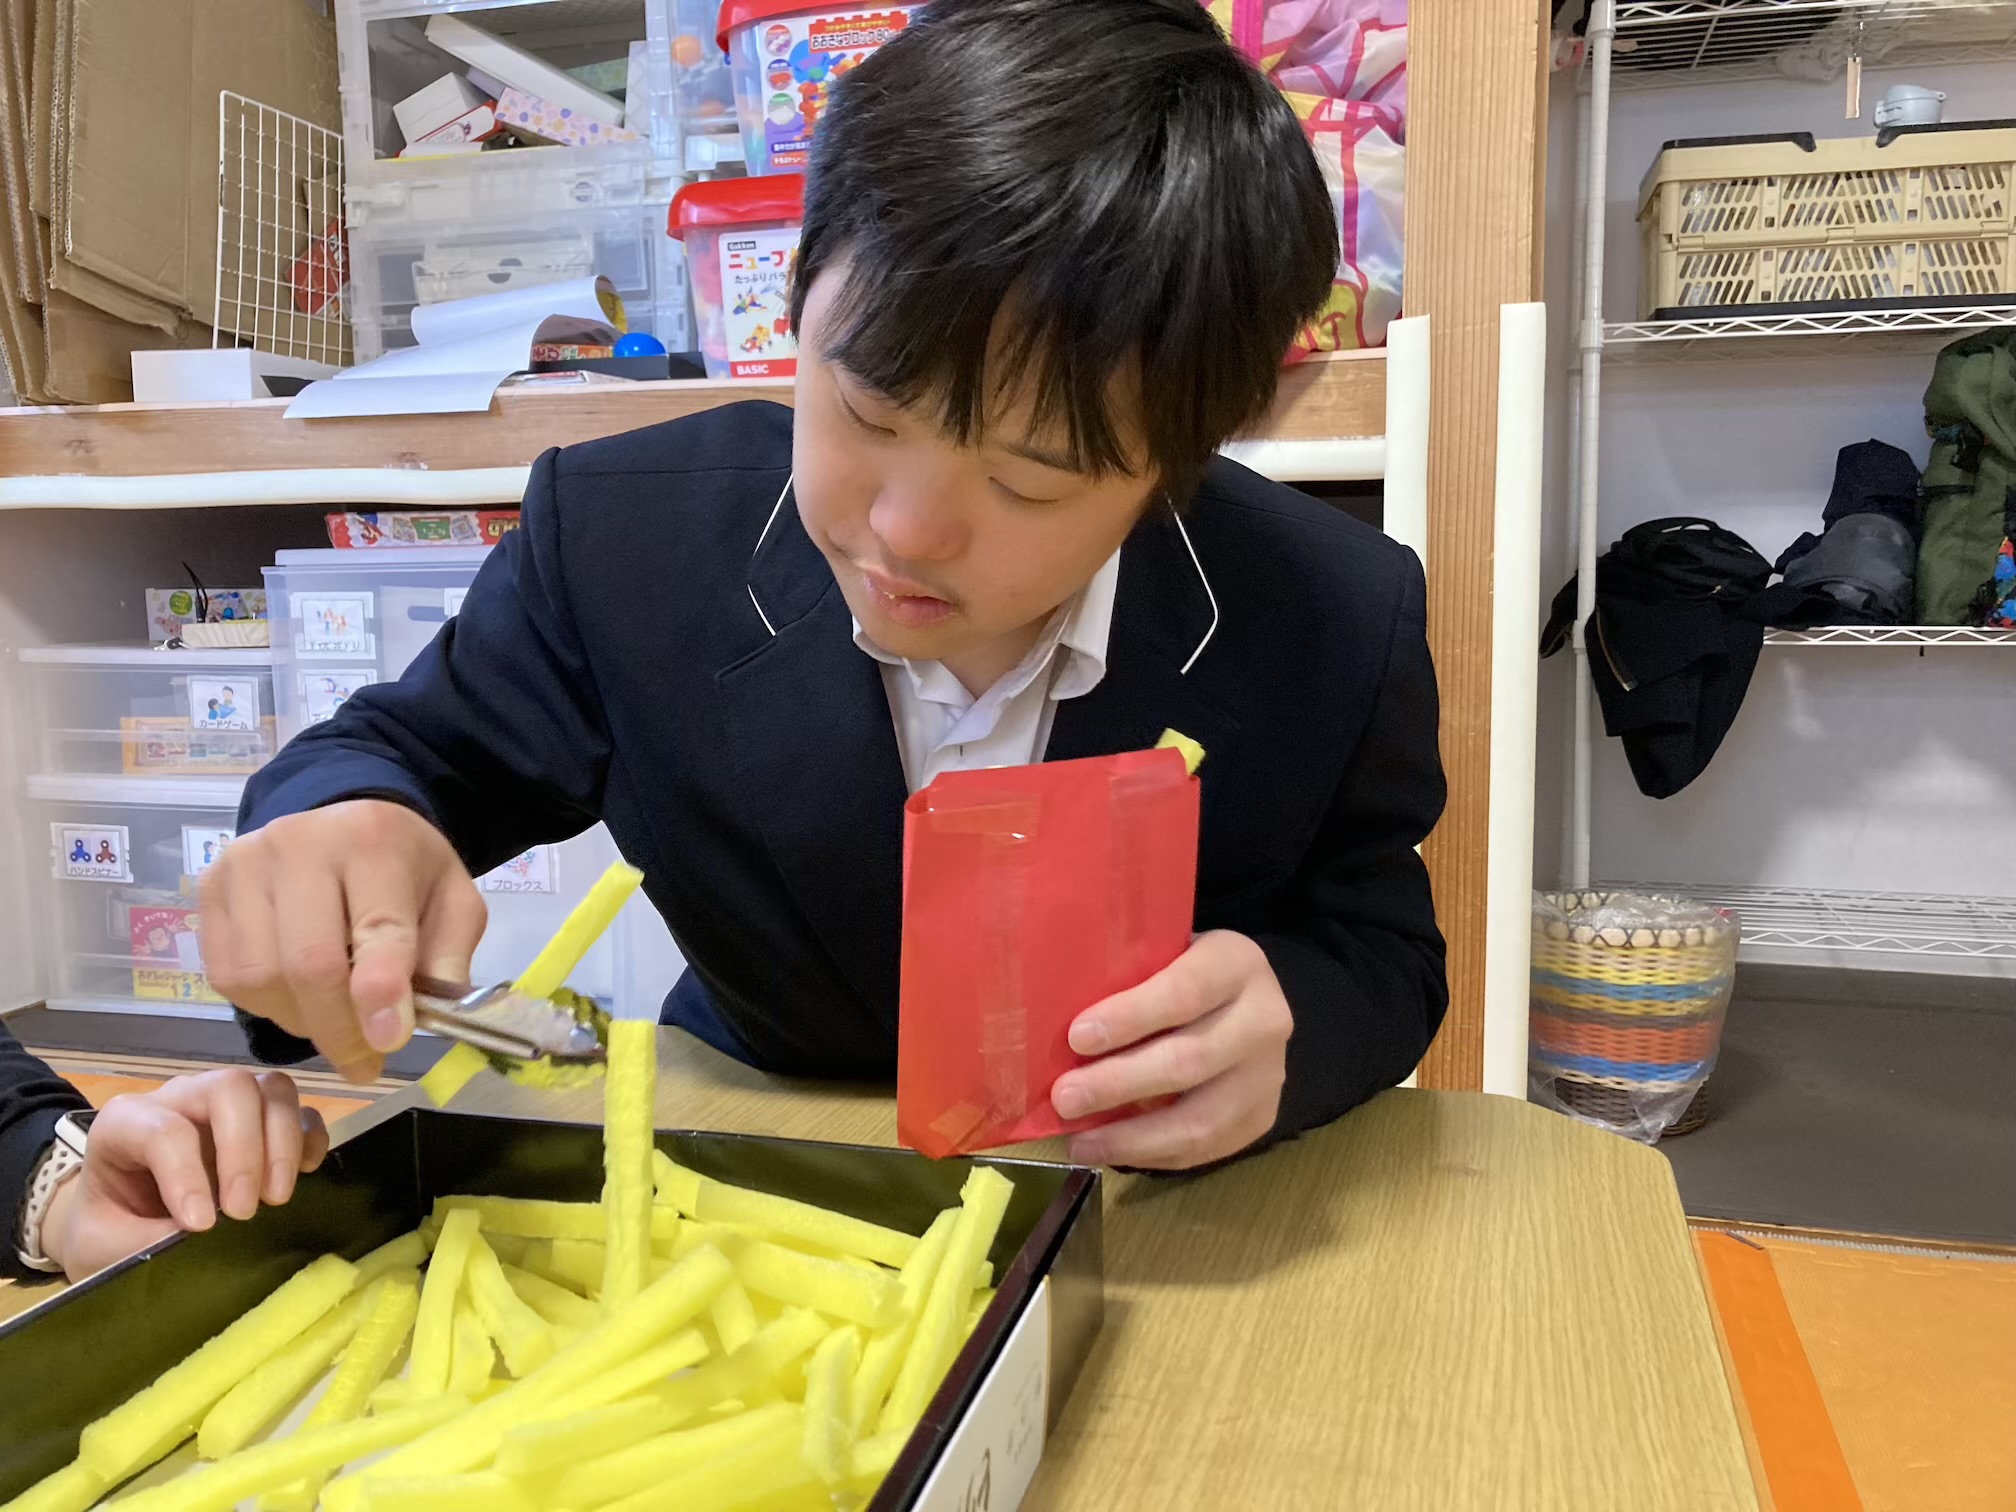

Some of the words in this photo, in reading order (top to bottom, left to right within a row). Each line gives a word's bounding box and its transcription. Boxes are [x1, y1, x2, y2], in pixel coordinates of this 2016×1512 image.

[728, 242, 755, 250] Gakken
[737, 365, 769, 375] BASIC
[200, 719, 248, 731] カードゲーム
[70, 867, 119, 876] ハンドスピナー
[493, 880, 543, 891] ブロックス
